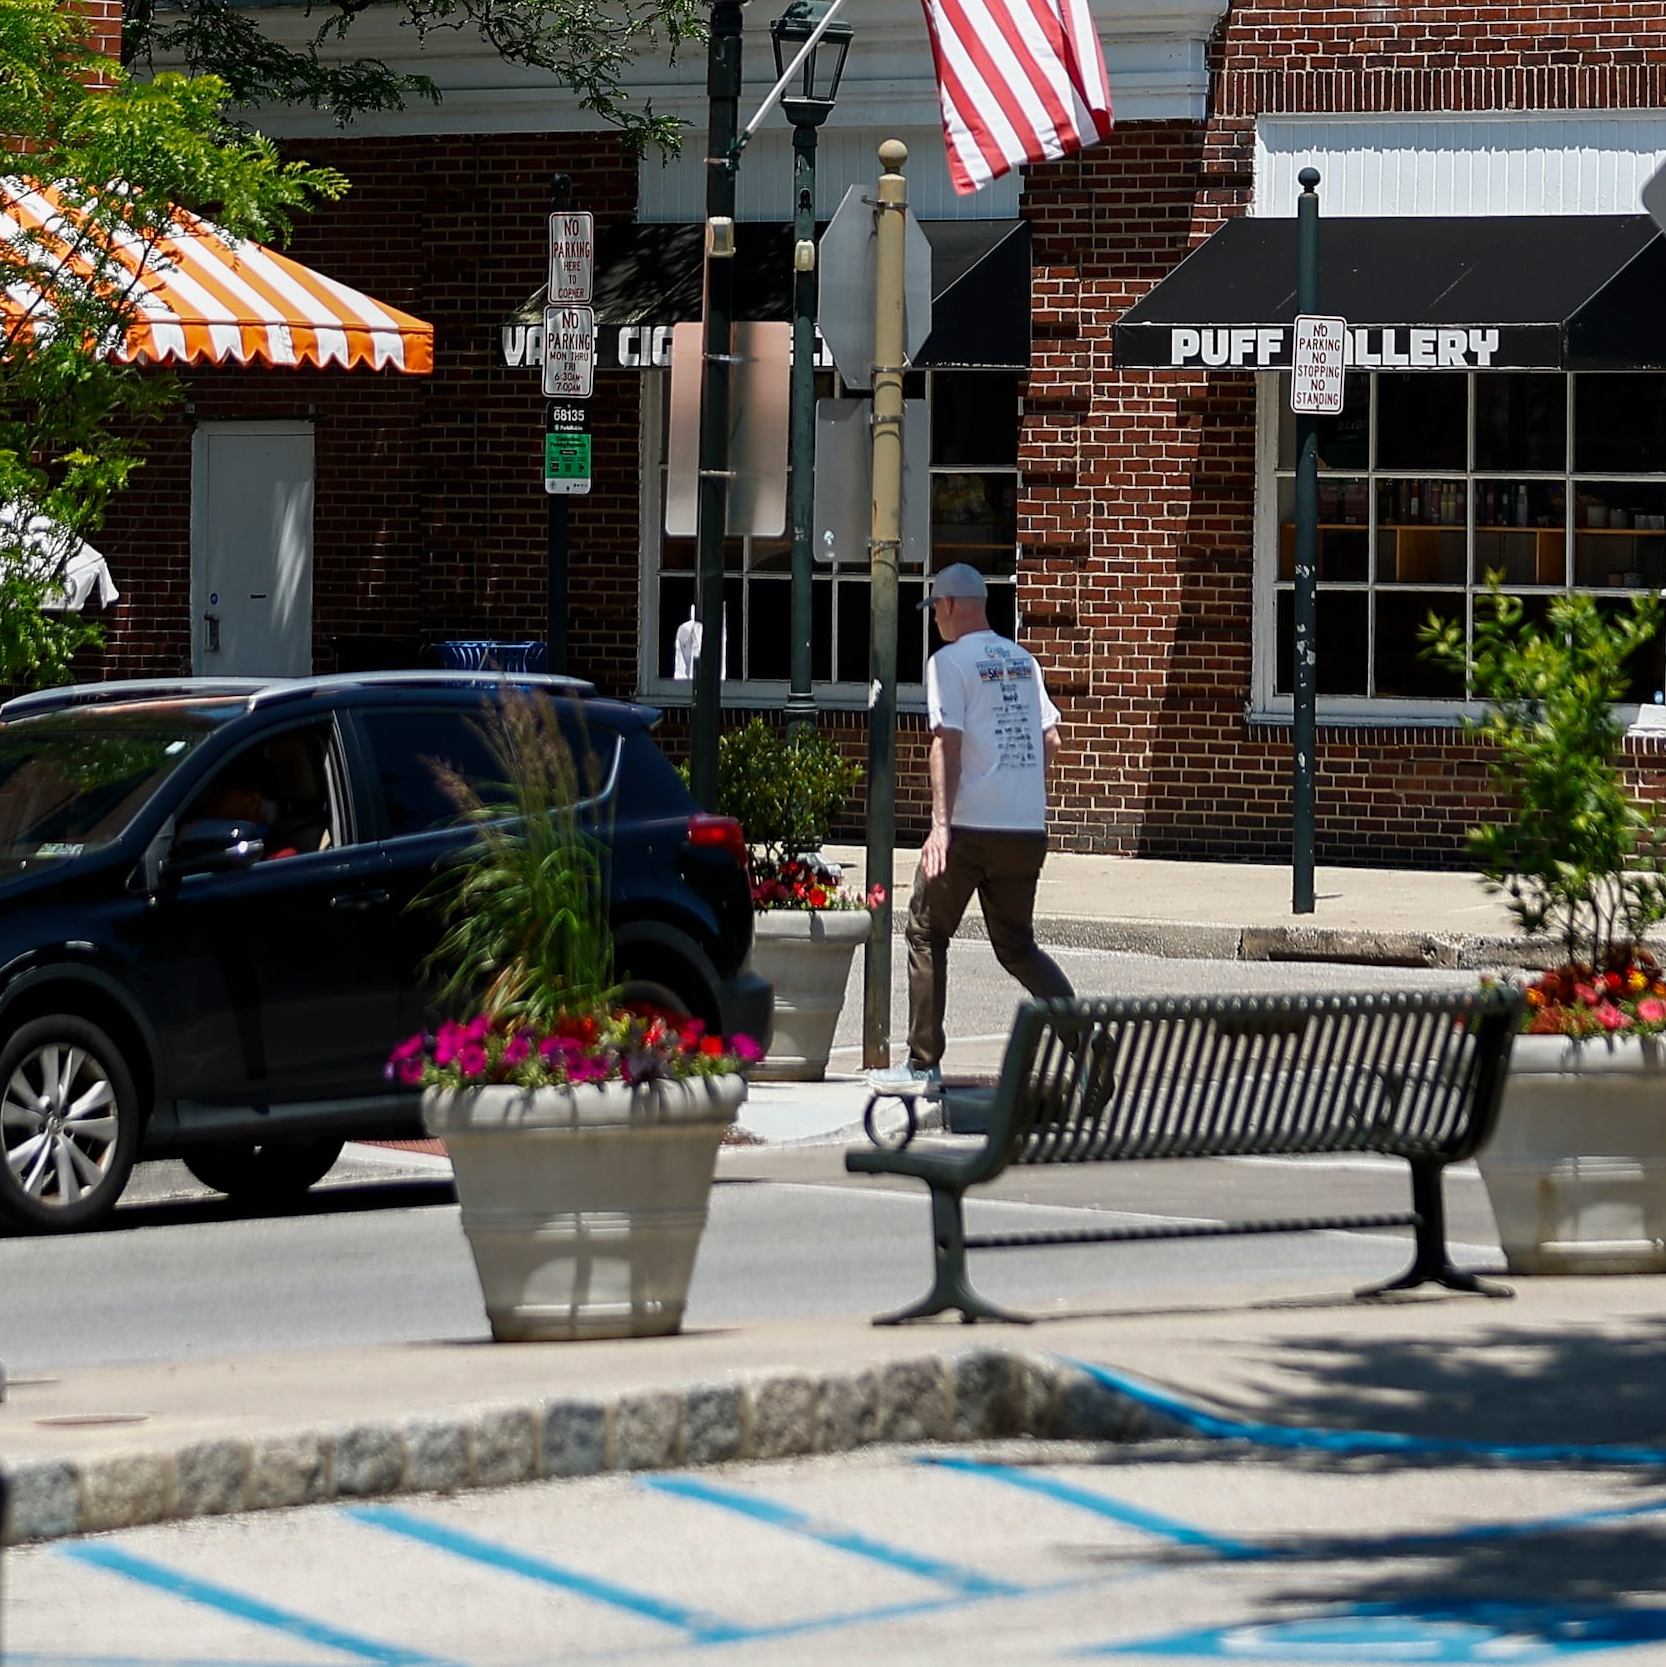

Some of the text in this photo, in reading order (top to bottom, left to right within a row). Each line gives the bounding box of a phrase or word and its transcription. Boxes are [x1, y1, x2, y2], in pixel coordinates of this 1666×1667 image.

[564, 219, 580, 236] NO
[553, 241, 590, 258] PARKING
[564, 261, 581, 271] HERE
[568, 274, 577, 285] TO
[558, 288, 585, 299] CORNER
[562, 311, 579, 330] NO
[1313, 325, 1328, 337] NO
[548, 332, 591, 351] PARKING
[1171, 328, 1284, 366] PUFF
[1299, 338, 1340, 351] PARKING
[550, 351, 589, 361] MON THRU
[1312, 352, 1326, 364] NO
[564, 362, 576, 372] FRI
[1298, 365, 1340, 379] STOPPING
[1311, 379, 1325, 391] NO
[1296, 392, 1339, 406] STANDING
[553, 409, 585, 422] 68135
